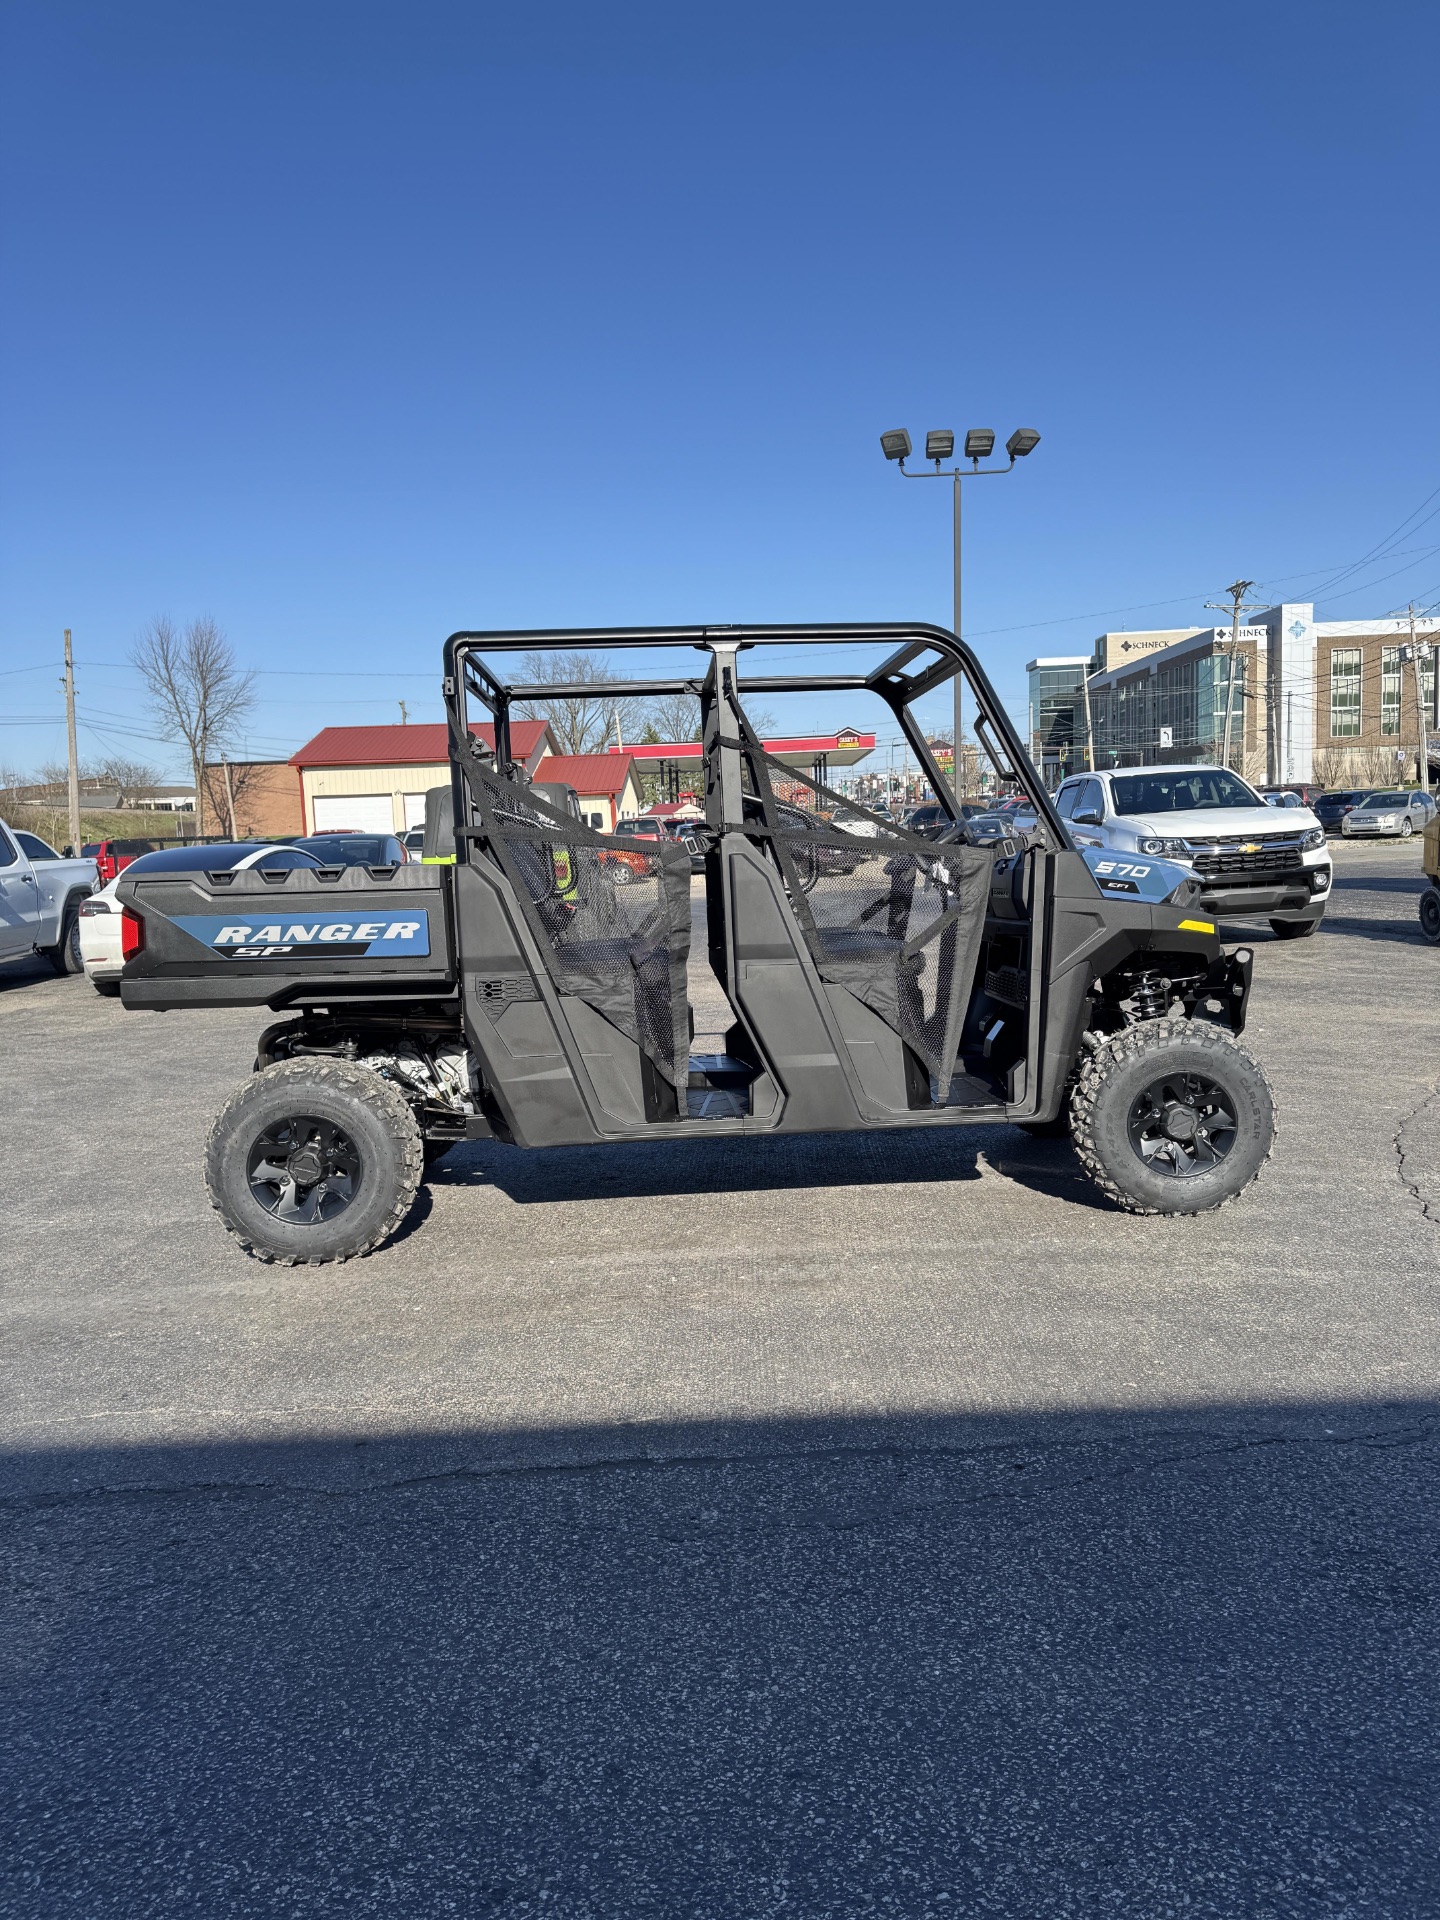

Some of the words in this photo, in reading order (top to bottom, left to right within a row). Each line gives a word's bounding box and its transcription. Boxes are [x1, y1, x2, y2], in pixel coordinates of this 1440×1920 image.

[1228, 628, 1272, 638] SHNECK
[1132, 641, 1170, 650] SCHNECK
[1094, 861, 1151, 878] 570
[213, 922, 421, 944] RANGER
[232, 946, 294, 957] SP
[1239, 1077, 1261, 1140] CARLSTAR
